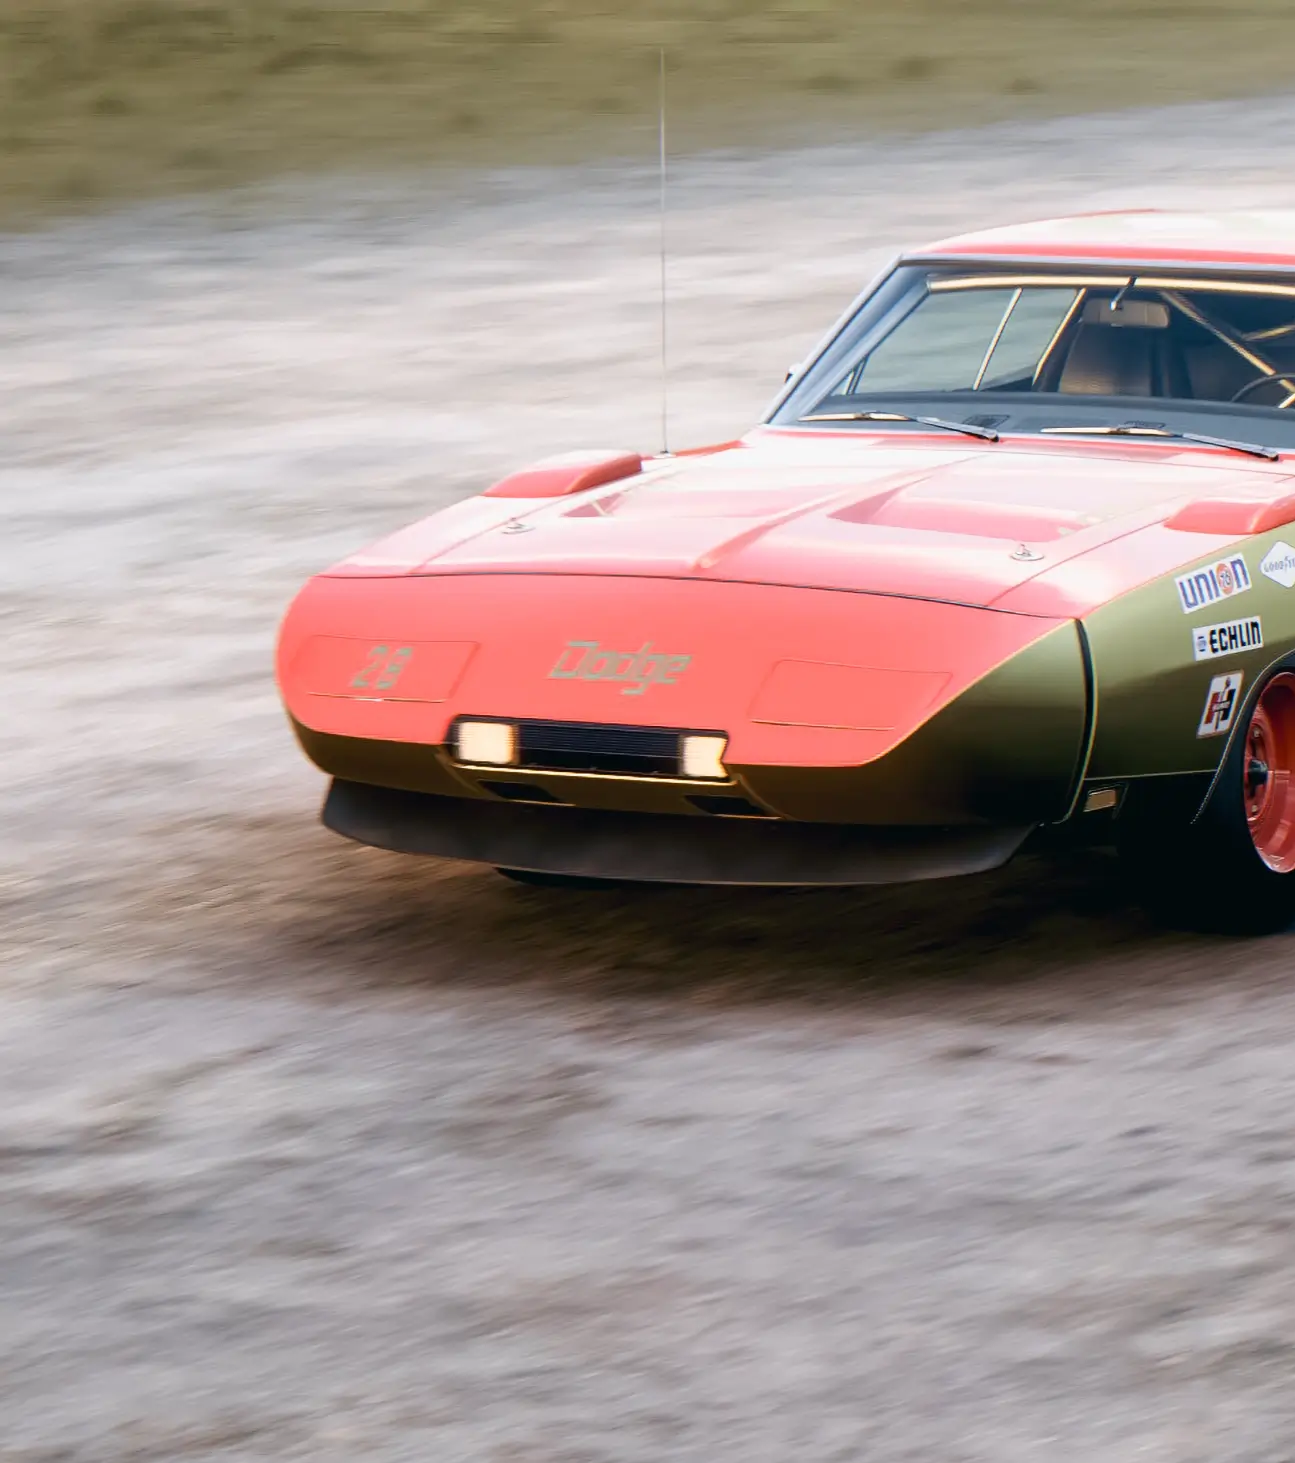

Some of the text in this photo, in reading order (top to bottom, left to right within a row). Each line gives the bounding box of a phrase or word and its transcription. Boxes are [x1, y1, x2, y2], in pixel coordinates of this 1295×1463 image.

[1209, 621, 1262, 653] ECHLIN
[350, 645, 413, 690] 28
[548, 640, 692, 696] Dodge
